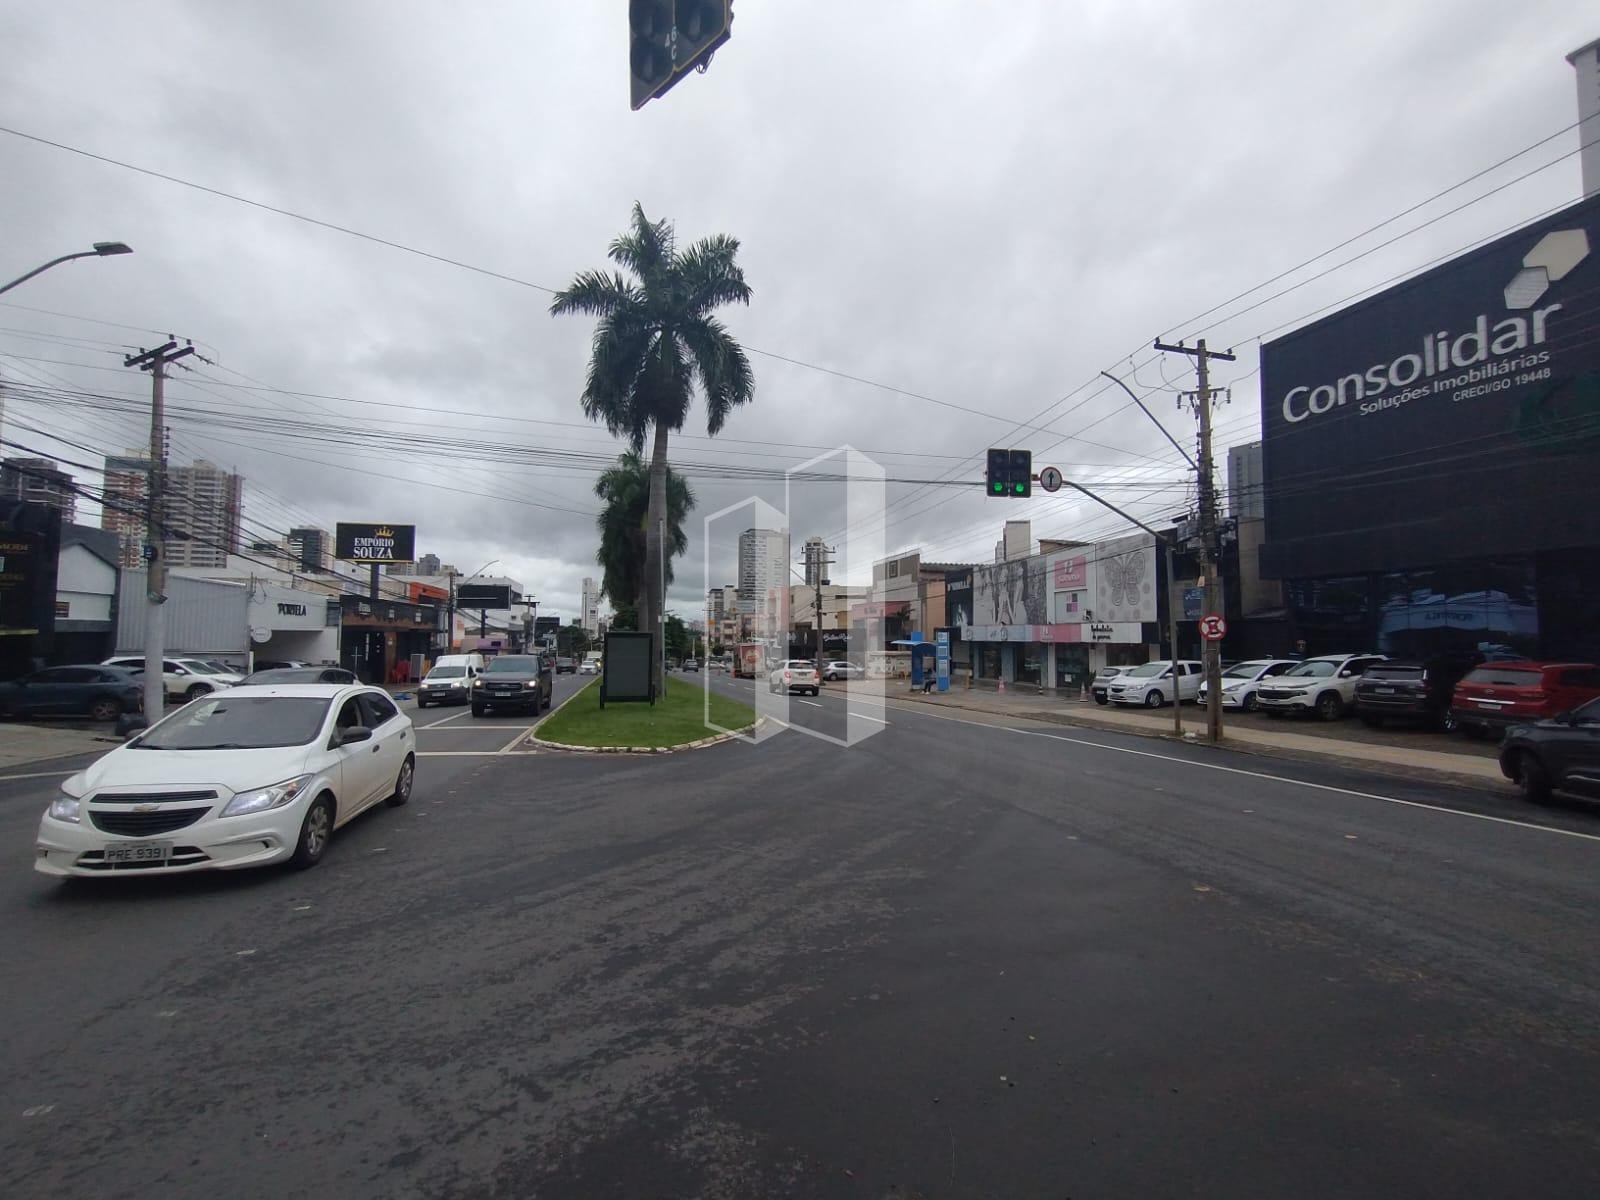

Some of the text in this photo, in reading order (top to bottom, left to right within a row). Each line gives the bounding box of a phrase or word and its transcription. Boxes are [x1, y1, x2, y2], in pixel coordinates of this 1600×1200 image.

[1282, 303, 1563, 423] Consolidar
[1360, 351, 1551, 416] Soluções Imobiliárias
[1453, 367, 1551, 403] CRECI/GO 19448
[353, 547, 394, 559] SOUZA
[354, 536, 394, 547] EMPÓRIO
[277, 603, 307, 616] PORTELA
